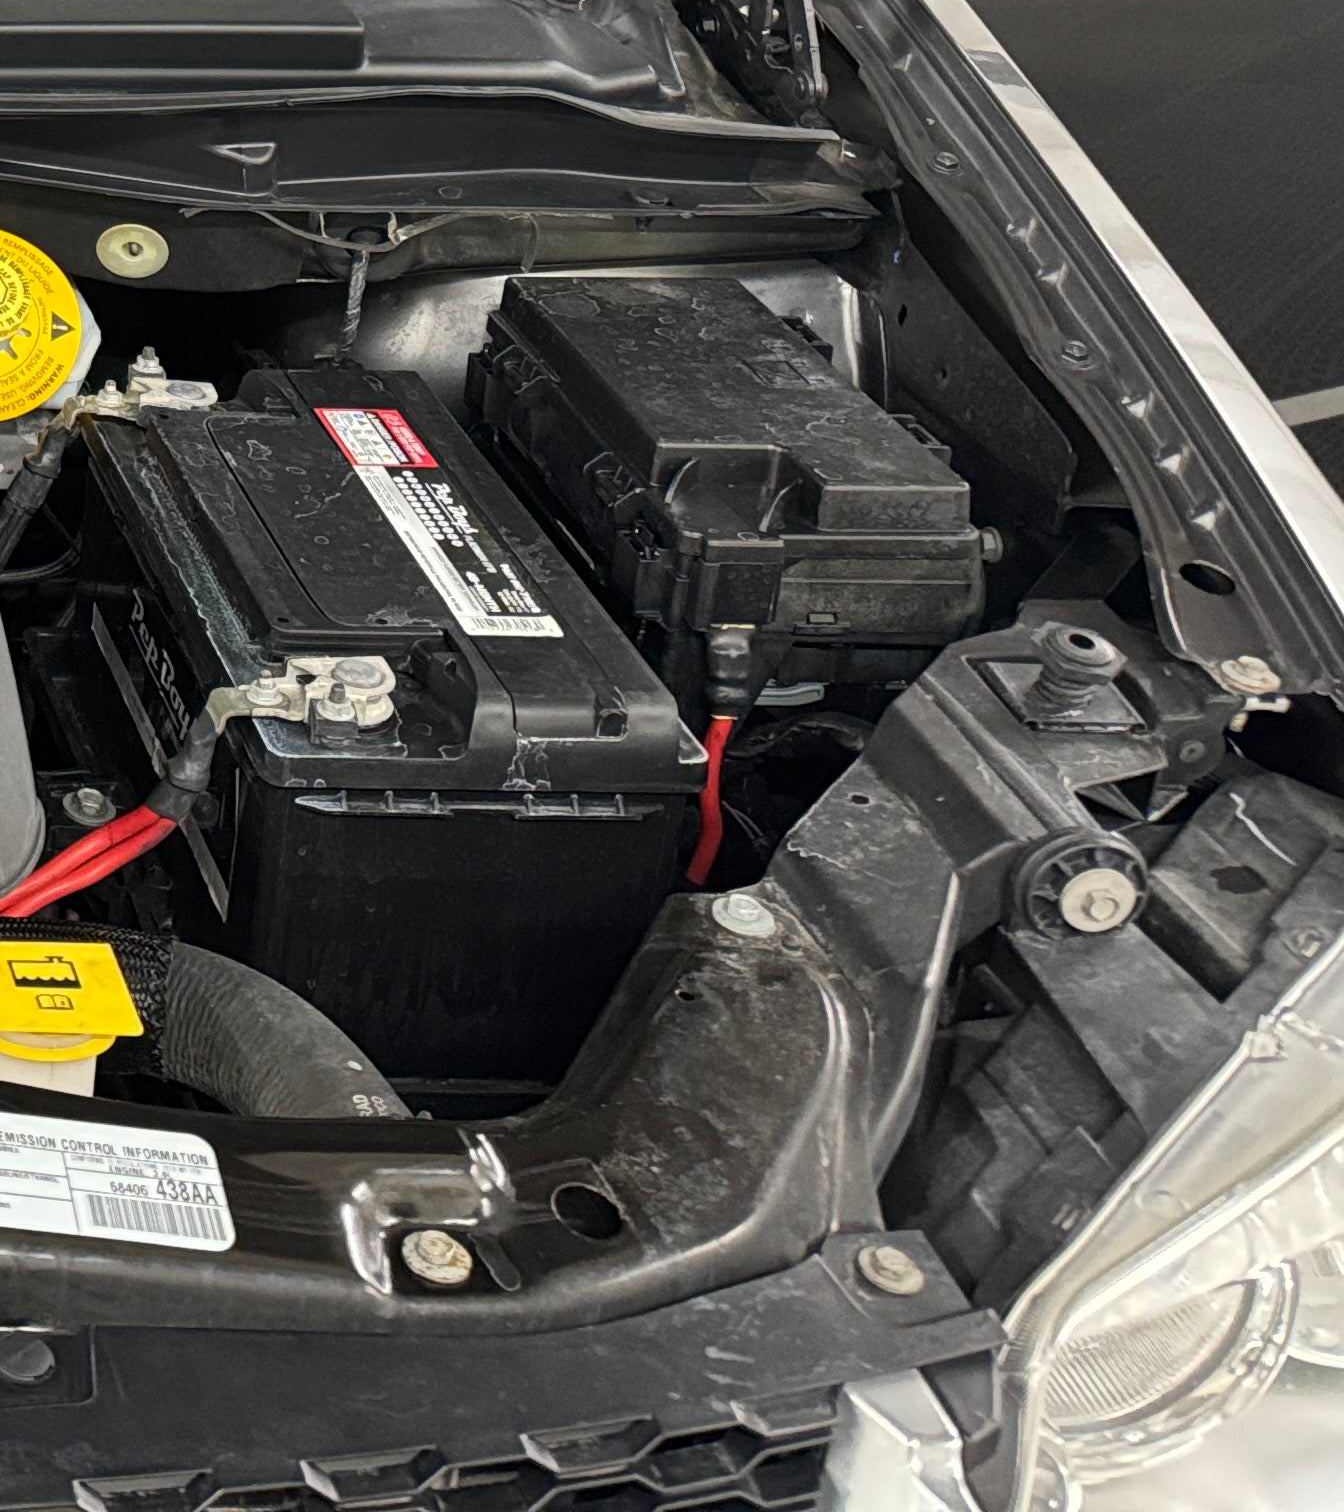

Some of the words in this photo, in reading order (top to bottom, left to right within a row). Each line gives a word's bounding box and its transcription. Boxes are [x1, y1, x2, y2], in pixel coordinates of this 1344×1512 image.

[3, 238, 55, 276] REMPLISSAGE
[19, 368, 26, 376] A
[25, 348, 44, 371] FROM
[26, 363, 65, 401] WARNING:
[0, 398, 26, 414] CLEAN
[1, 389, 18, 402] USE
[431, 483, 453, 504] Pep
[447, 505, 479, 534] Boys
[132, 588, 159, 671] Pep
[60, 1138, 118, 1155] CONTROL
[121, 1145, 209, 1165] INFORMATION
[109, 1181, 149, 1196] 68406
[155, 1179, 220, 1205] 438AA
